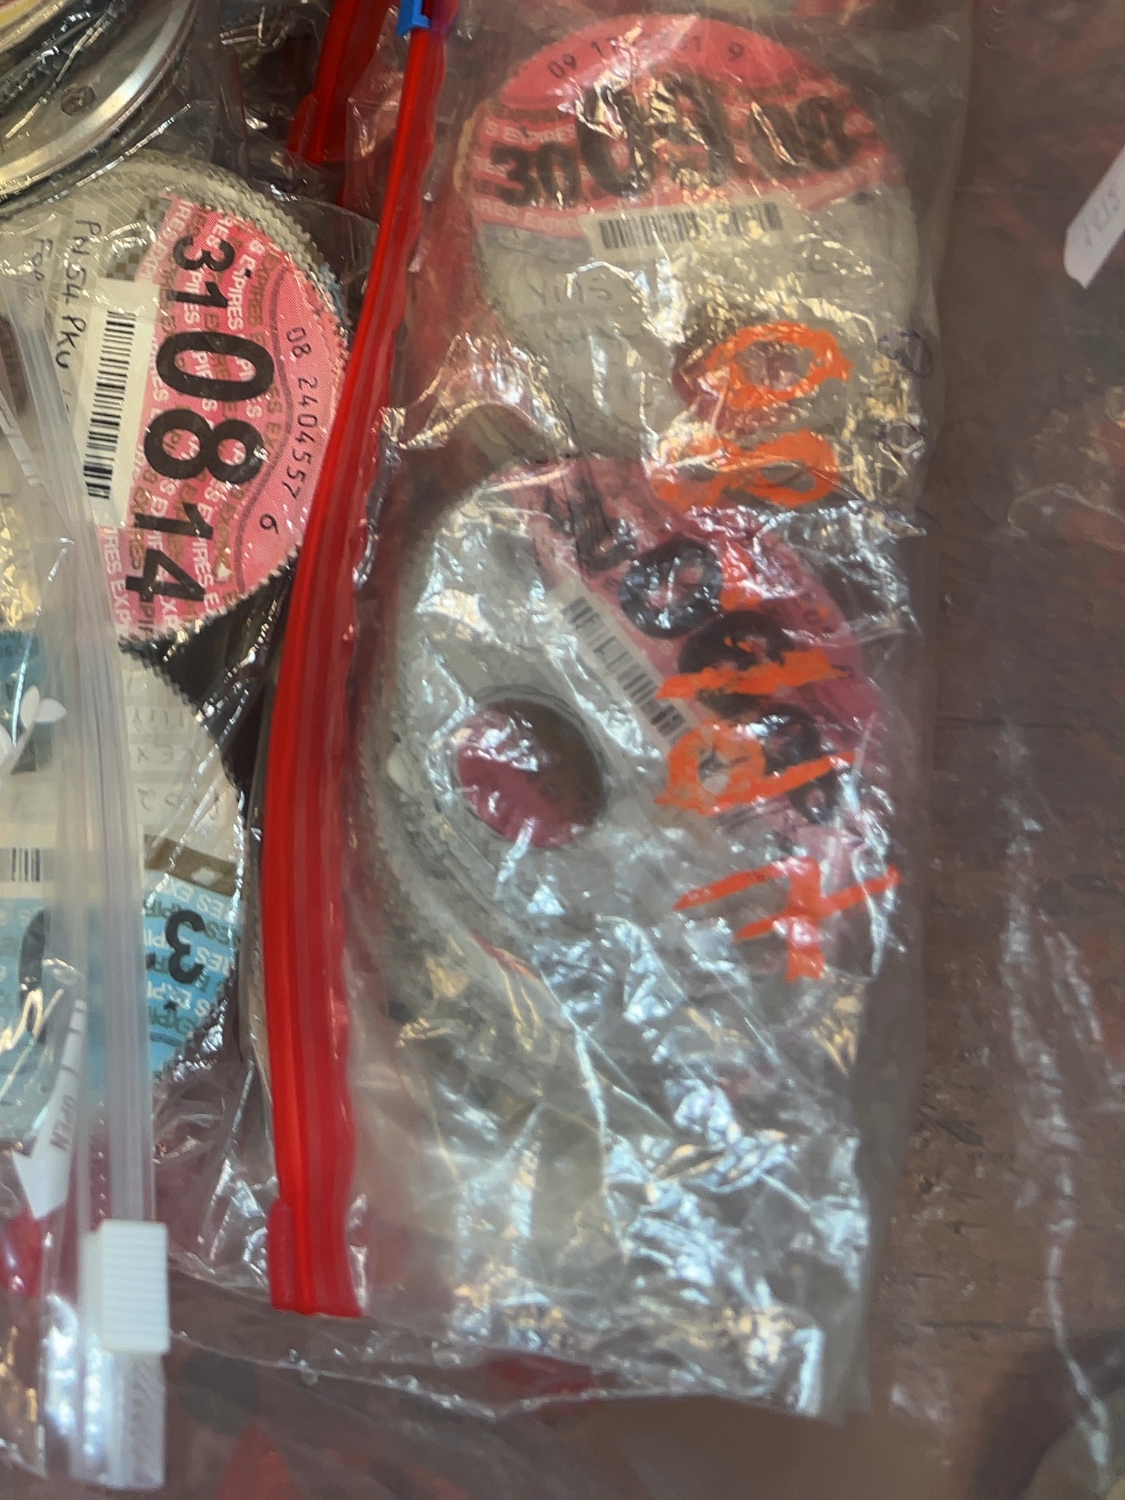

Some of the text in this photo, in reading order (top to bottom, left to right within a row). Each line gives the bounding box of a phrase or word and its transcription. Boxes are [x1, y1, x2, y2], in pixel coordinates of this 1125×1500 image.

[119, 231, 284, 613] 31 08 14
[255, 324, 326, 534] 08 2404557 6
